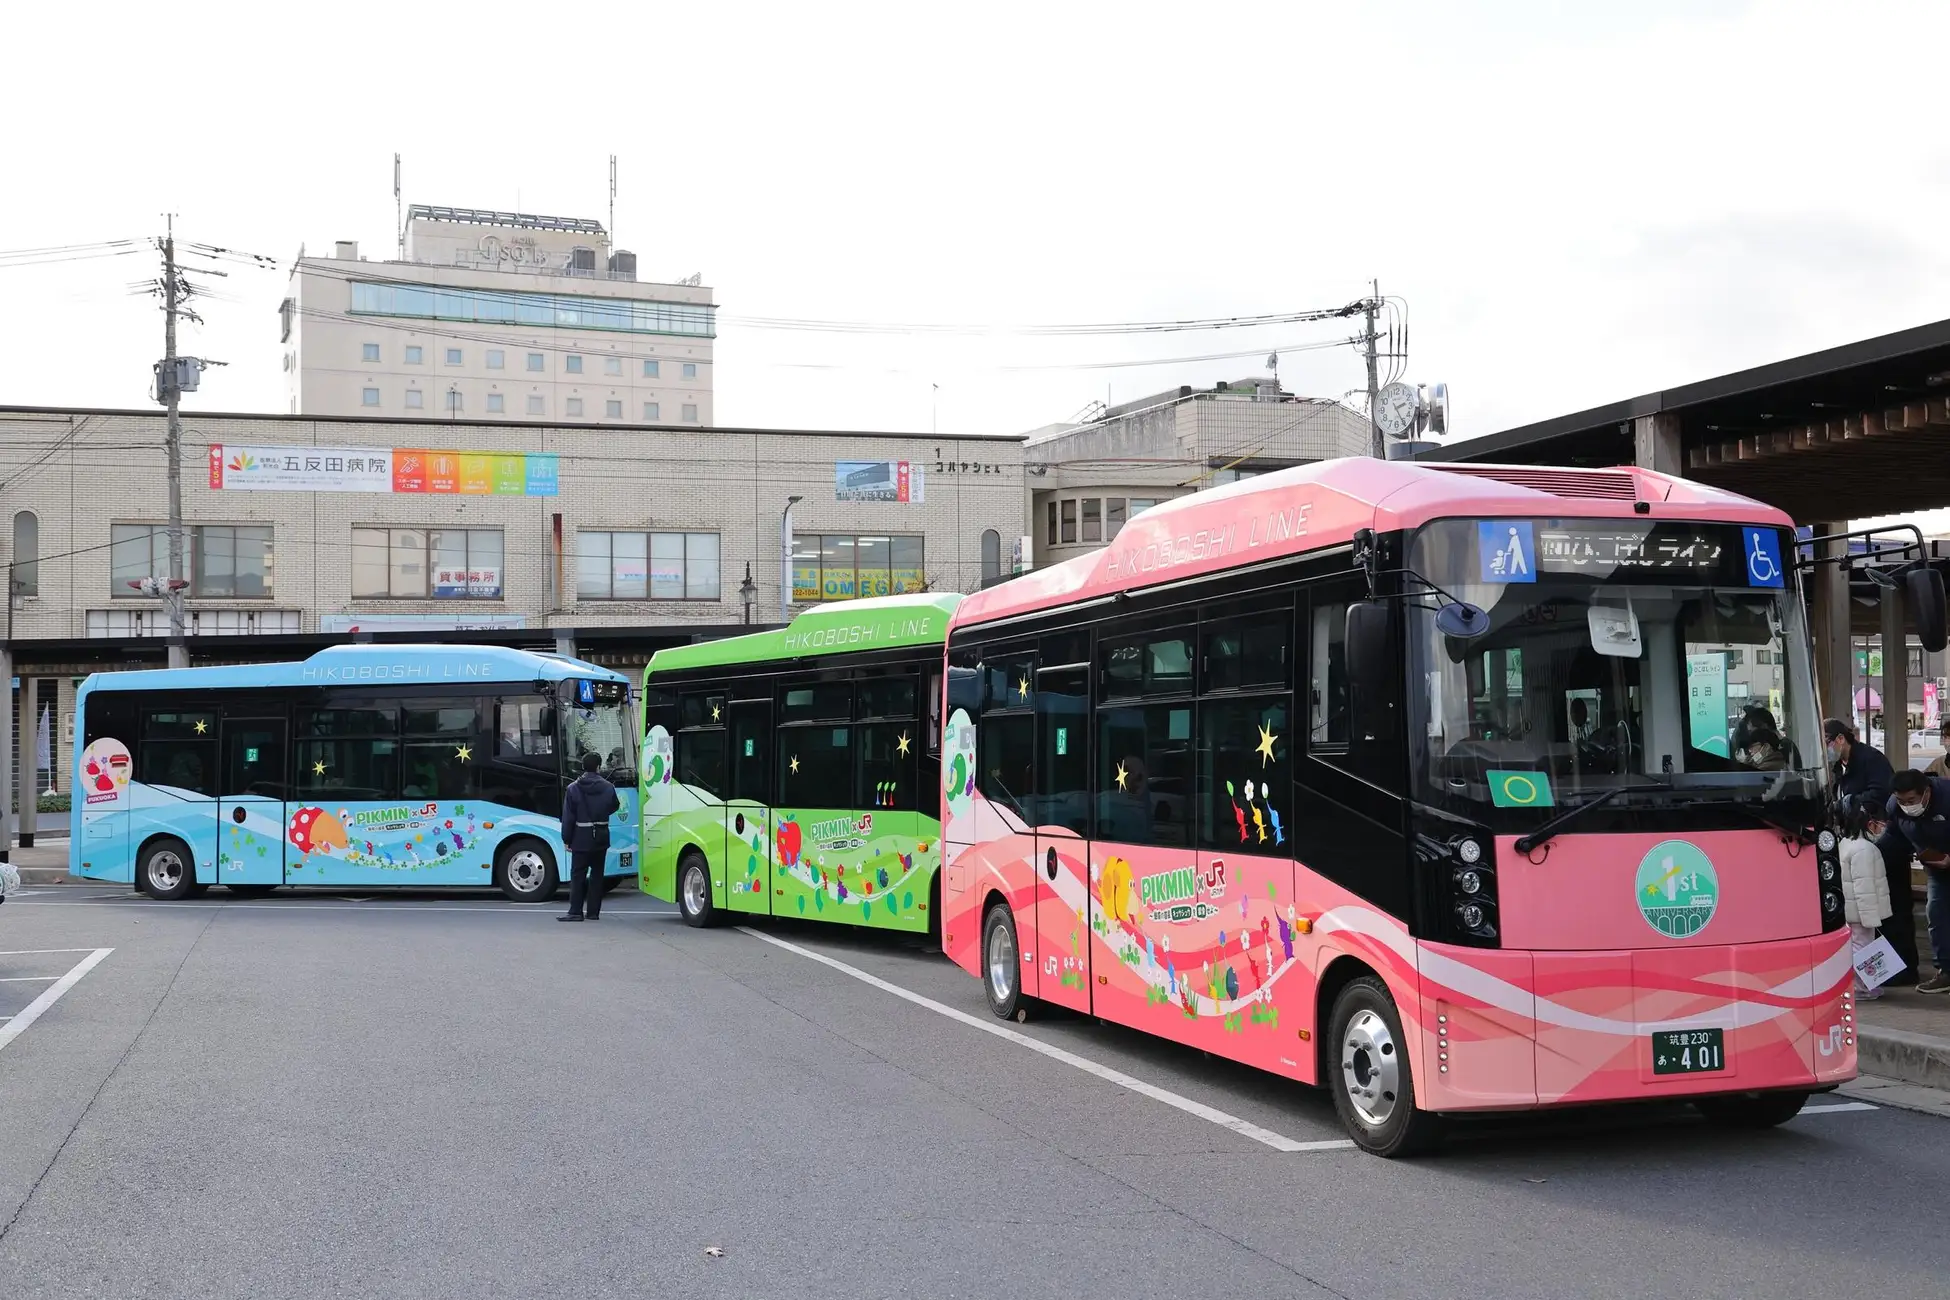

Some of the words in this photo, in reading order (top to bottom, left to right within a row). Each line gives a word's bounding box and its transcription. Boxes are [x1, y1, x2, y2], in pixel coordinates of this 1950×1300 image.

[282, 456, 386, 473] 五反田病院
[1106, 523, 1236, 581] HIKOBOSHI
[1249, 503, 1312, 548] LINE
[825, 580, 905, 595] OMEGA
[785, 624, 880, 649] HIKOBOSHI
[890, 618, 931, 639] LINE
[303, 665, 430, 680] HIKOBOSHI
[444, 663, 493, 677] LINE
[88, 793, 116, 803] FUKUOKA
[356, 807, 409, 825] PIKMIN
[420, 802, 438, 815] JR
[811, 818, 851, 841] PIKMIN
[858, 813, 872, 830] JR
[227, 860, 244, 871] JR
[1142, 867, 1195, 906] PIKMIN
[1206, 861, 1226, 888] JR
[1645, 907, 1713, 917] ANNIVERSARY
[1044, 956, 1058, 977] JR
[1690, 1032, 1709, 1045] 230
[1819, 1024, 1842, 1057] JR
